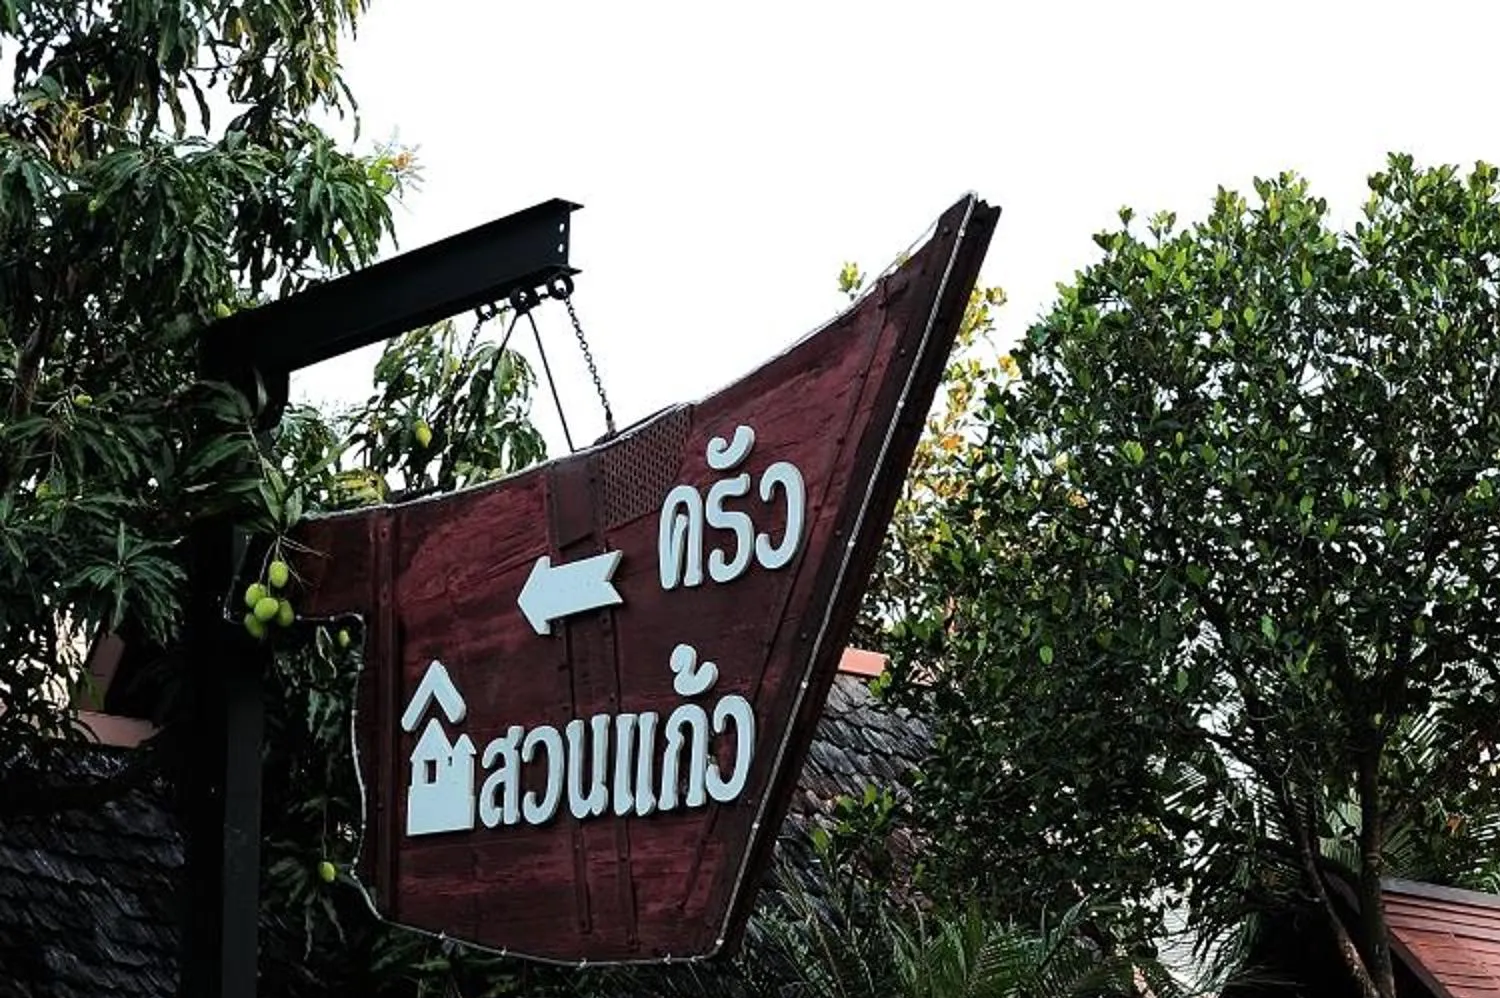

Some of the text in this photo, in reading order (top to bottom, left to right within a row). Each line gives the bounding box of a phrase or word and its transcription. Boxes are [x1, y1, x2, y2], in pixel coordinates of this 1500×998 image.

[658, 425, 806, 591] ครัว
[479, 643, 756, 829] สวนแก้ว
